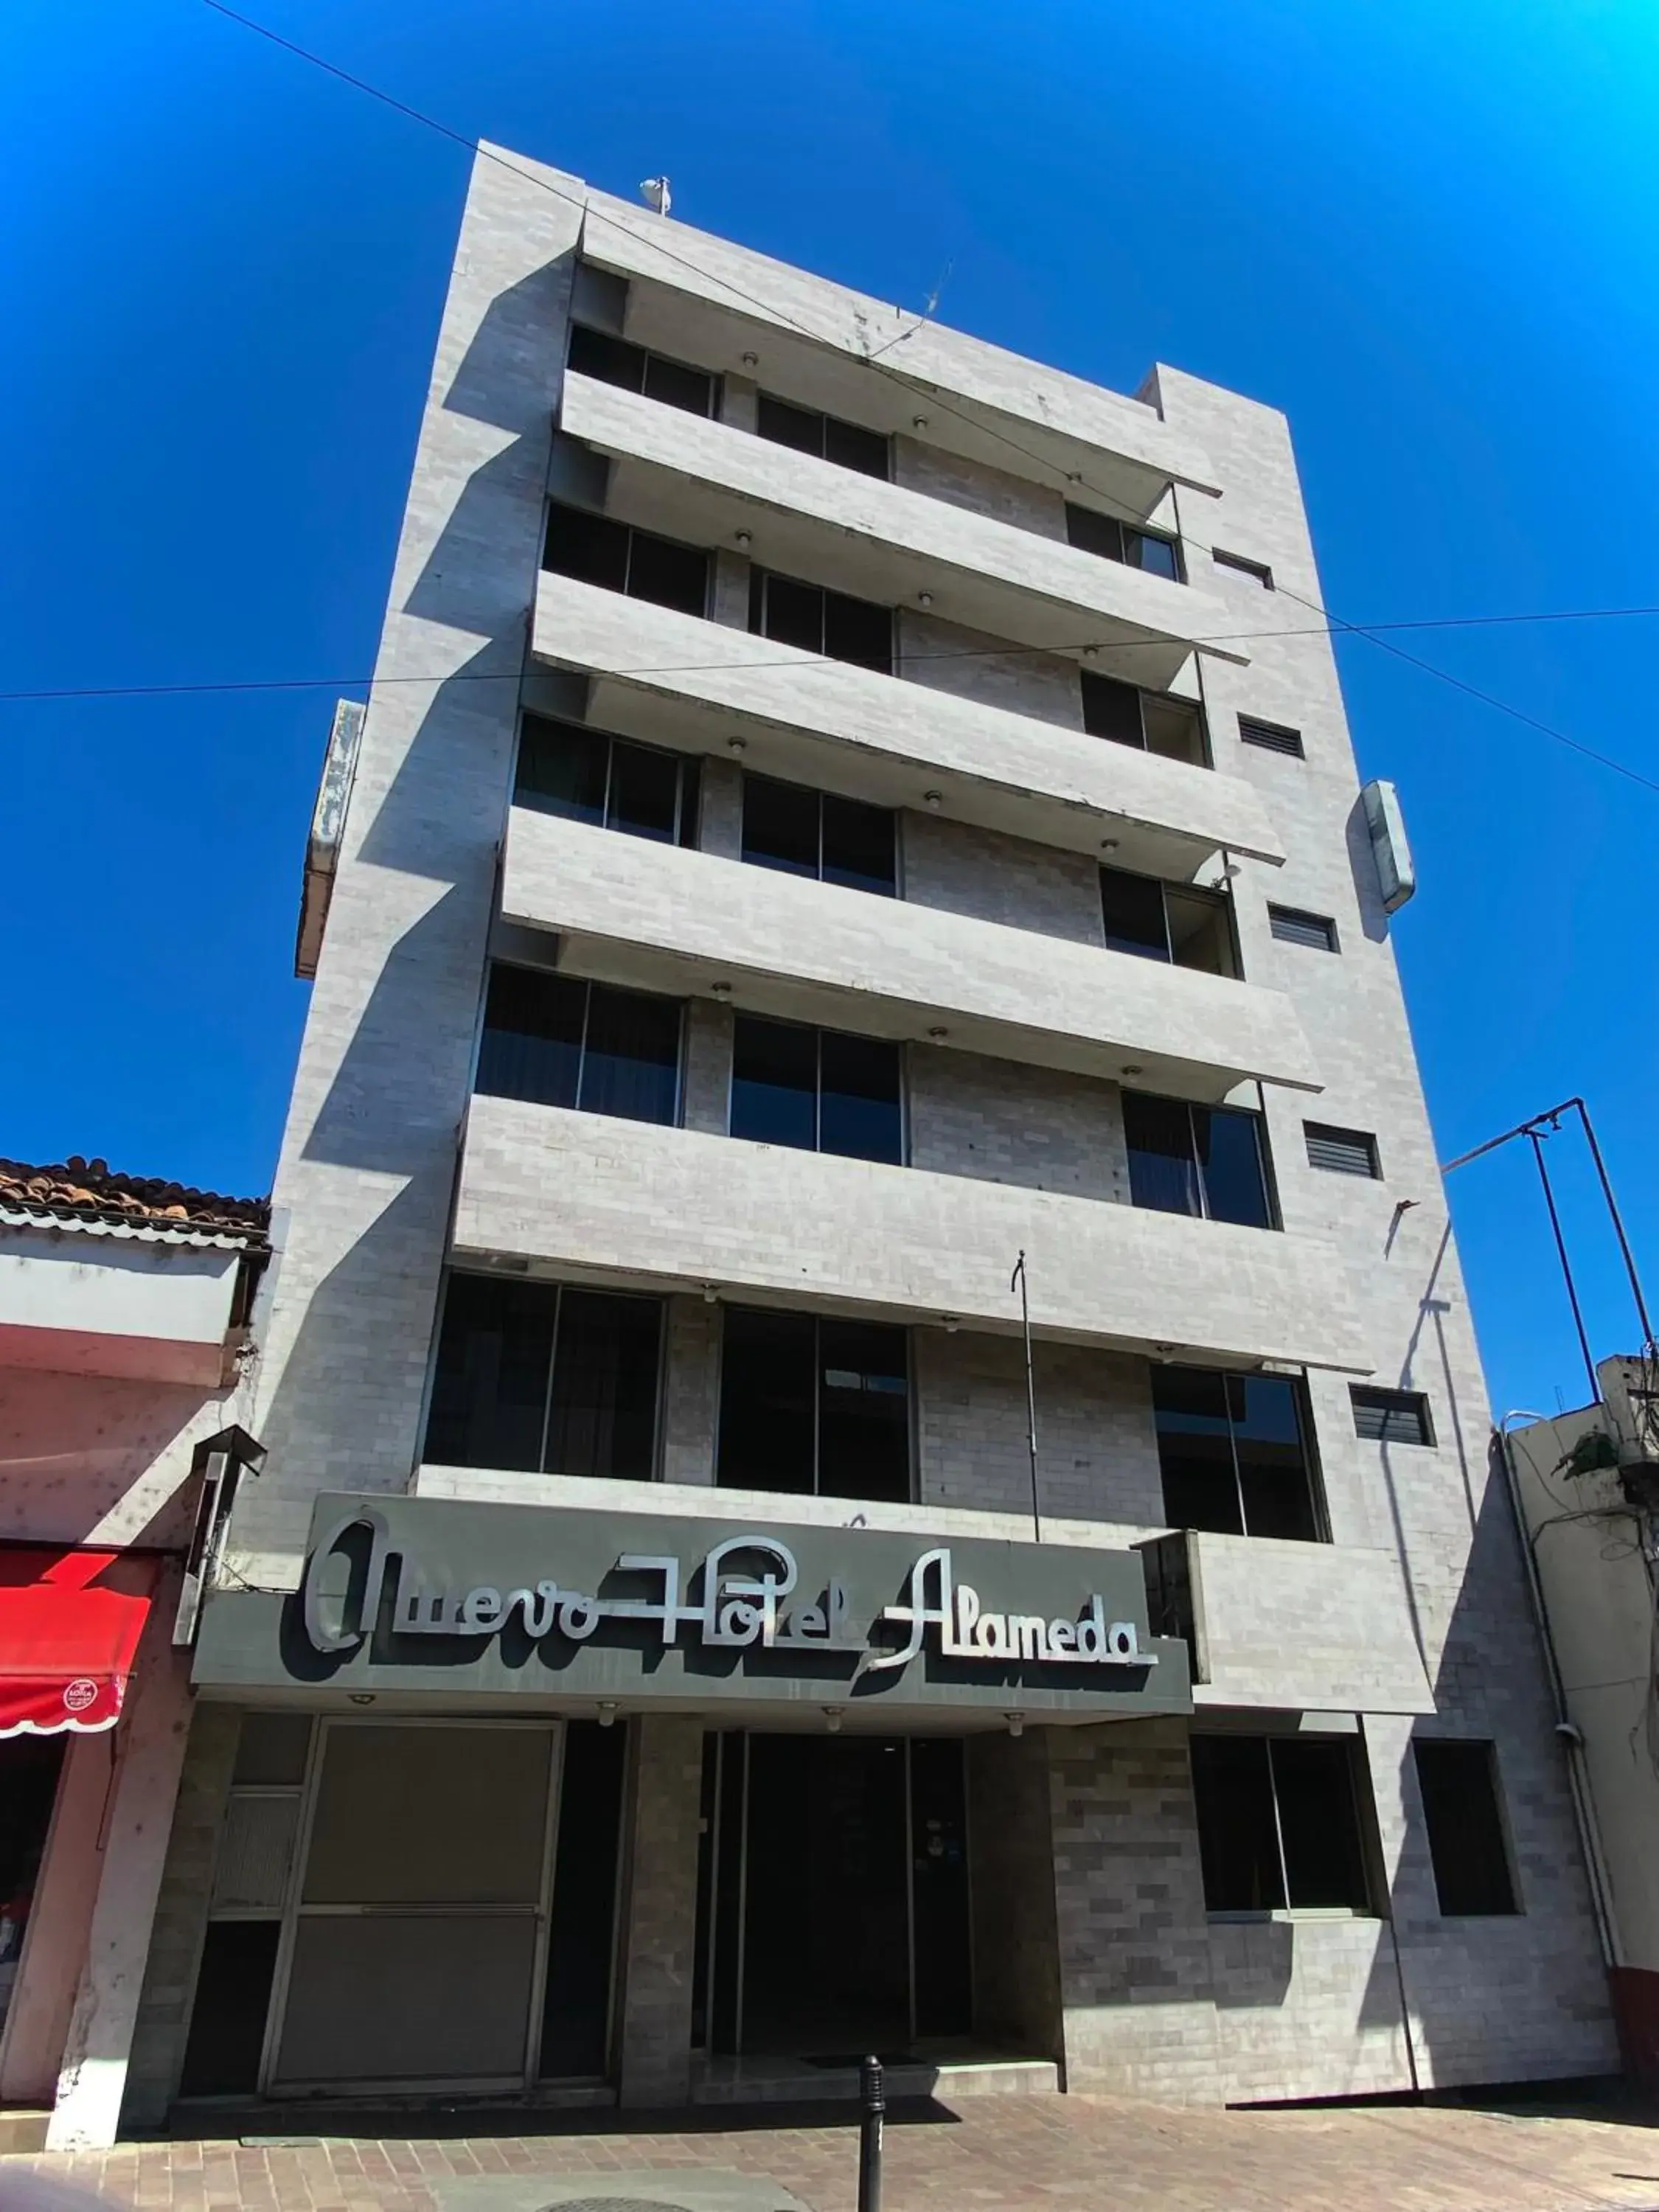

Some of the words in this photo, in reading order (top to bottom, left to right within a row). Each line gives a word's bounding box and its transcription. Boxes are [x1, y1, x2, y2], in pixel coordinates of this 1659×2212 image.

[305, 1508, 600, 1652] Nuevo
[605, 1535, 870, 1652] Hotel
[866, 1548, 1159, 1670] Alameda
